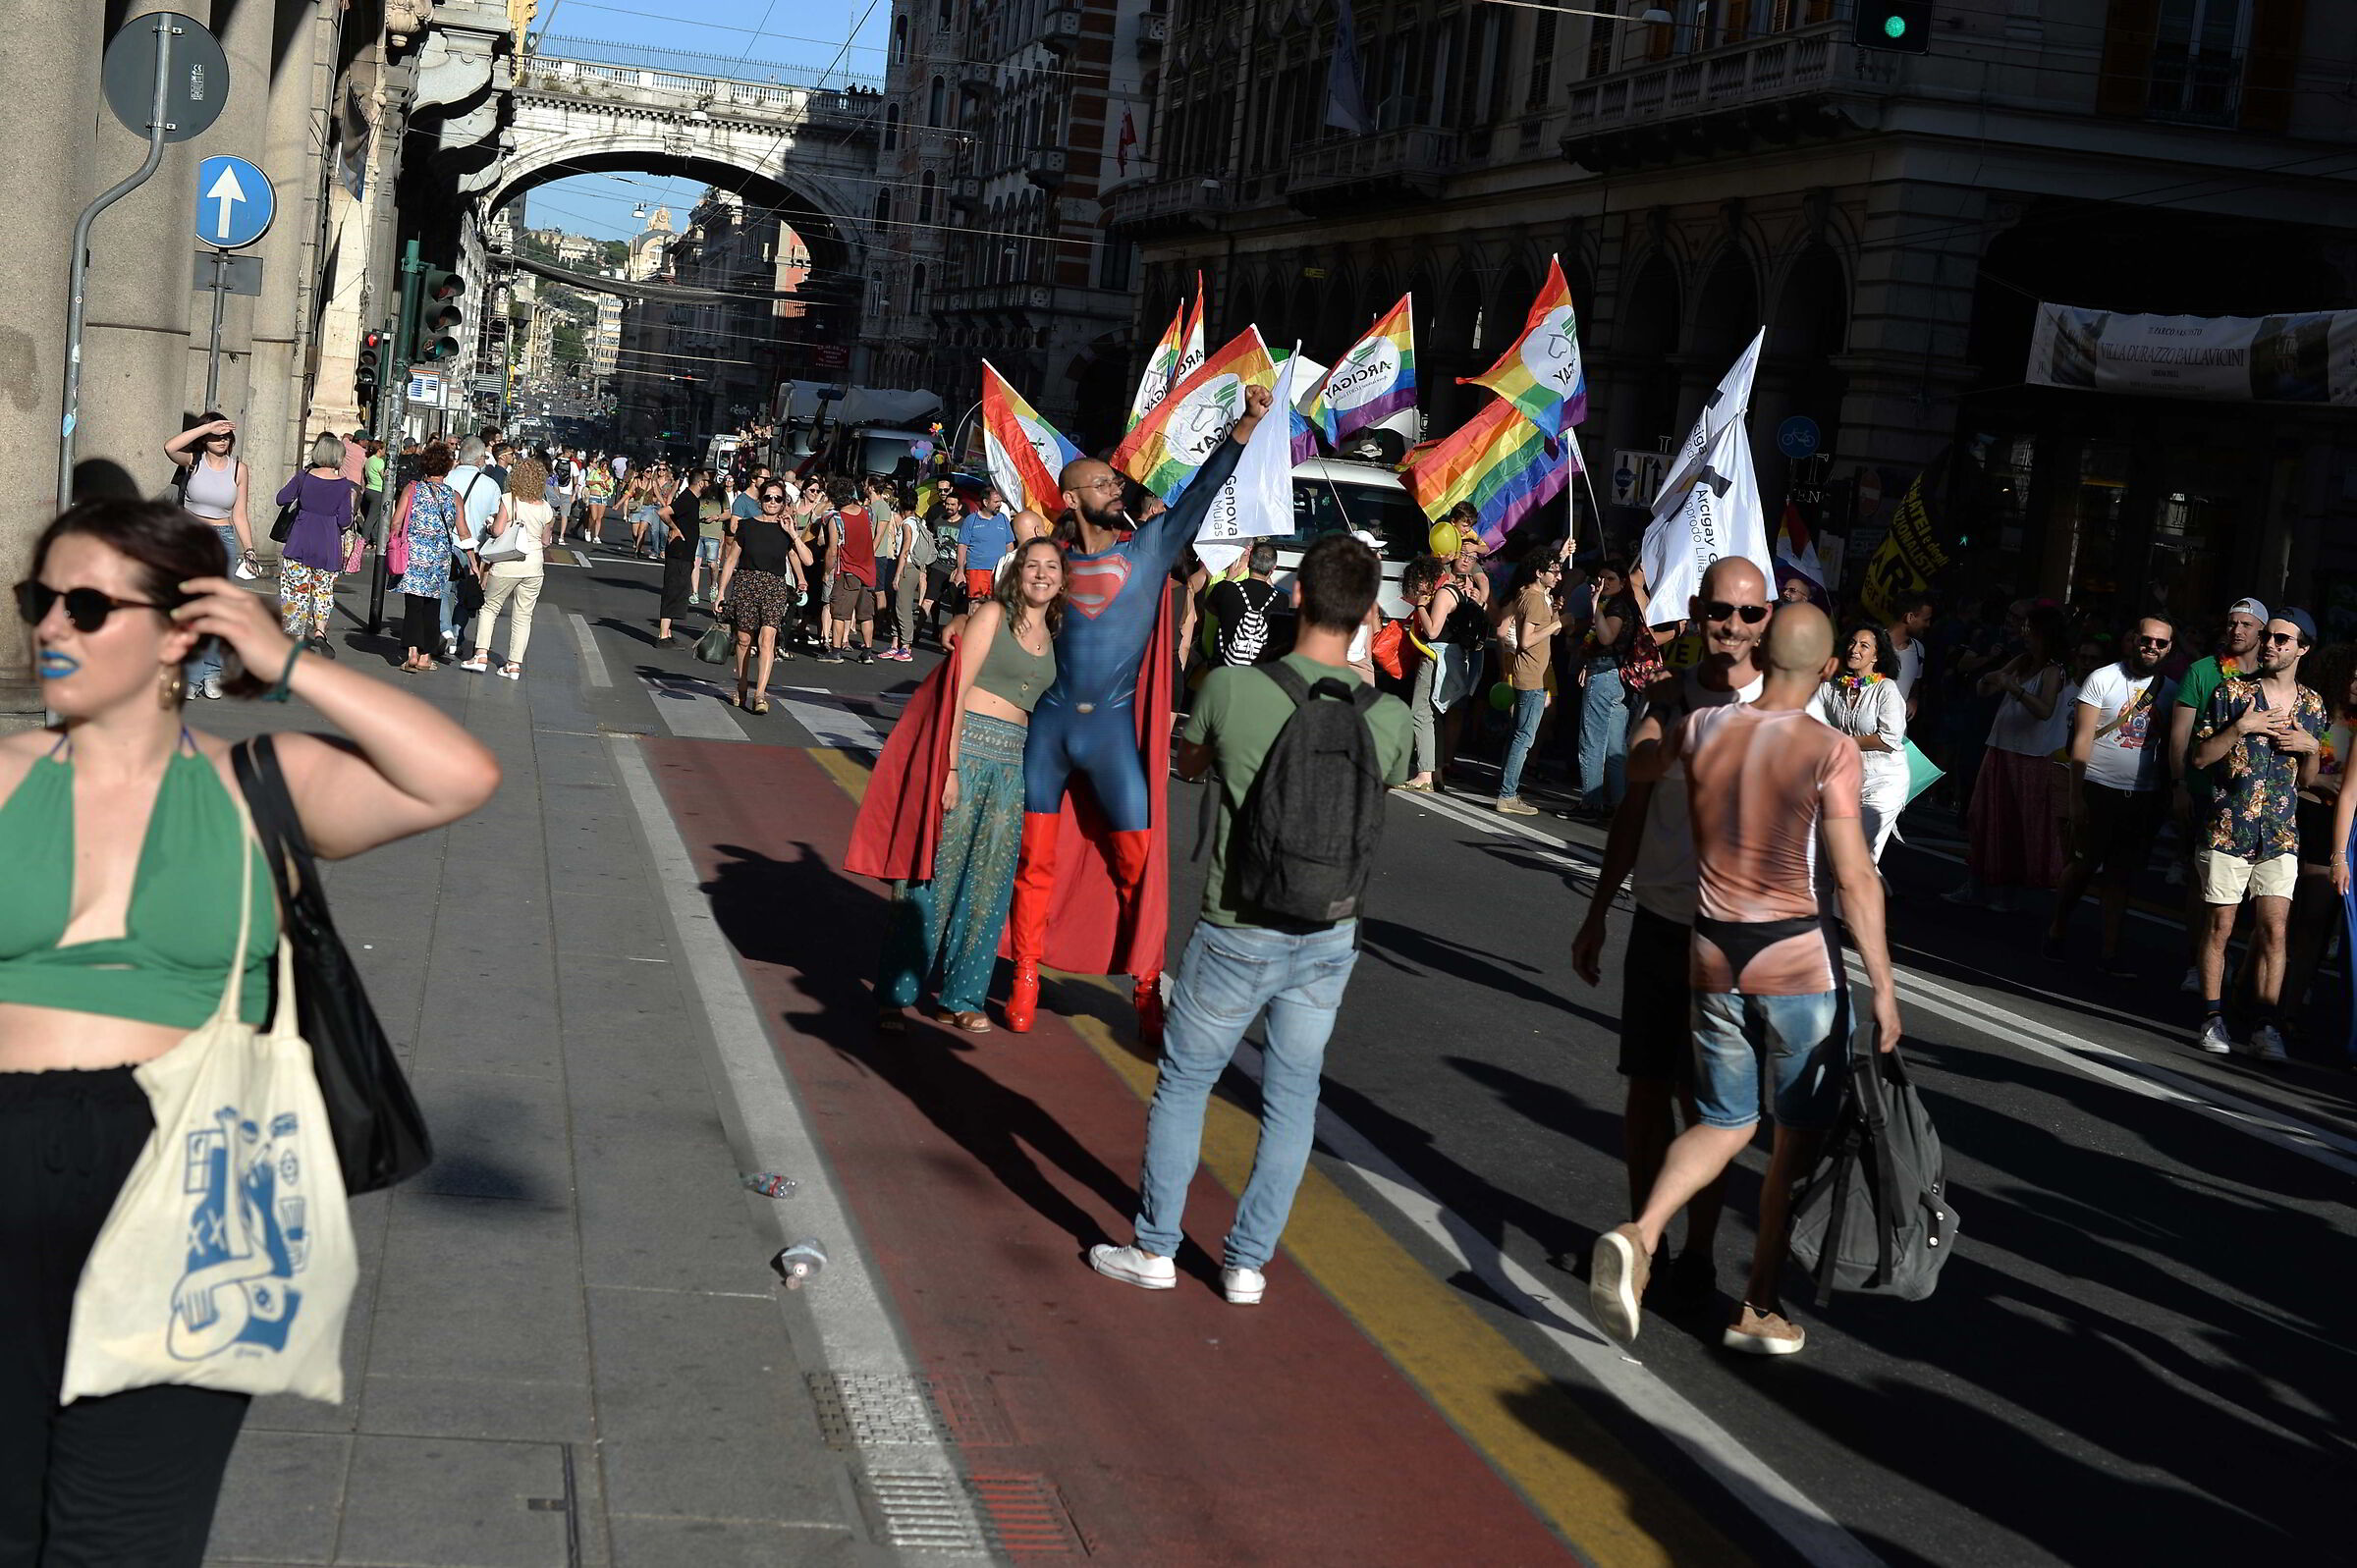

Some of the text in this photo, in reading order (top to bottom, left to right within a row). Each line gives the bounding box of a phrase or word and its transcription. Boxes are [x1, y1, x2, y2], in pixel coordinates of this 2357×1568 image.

[2101, 342, 2245, 367] VILLA DURAZZO PALLAVICINI
[1213, 499, 1224, 537] Mulas
[1225, 474, 1237, 536] Genova
[1695, 489, 1717, 548] Arcigay
